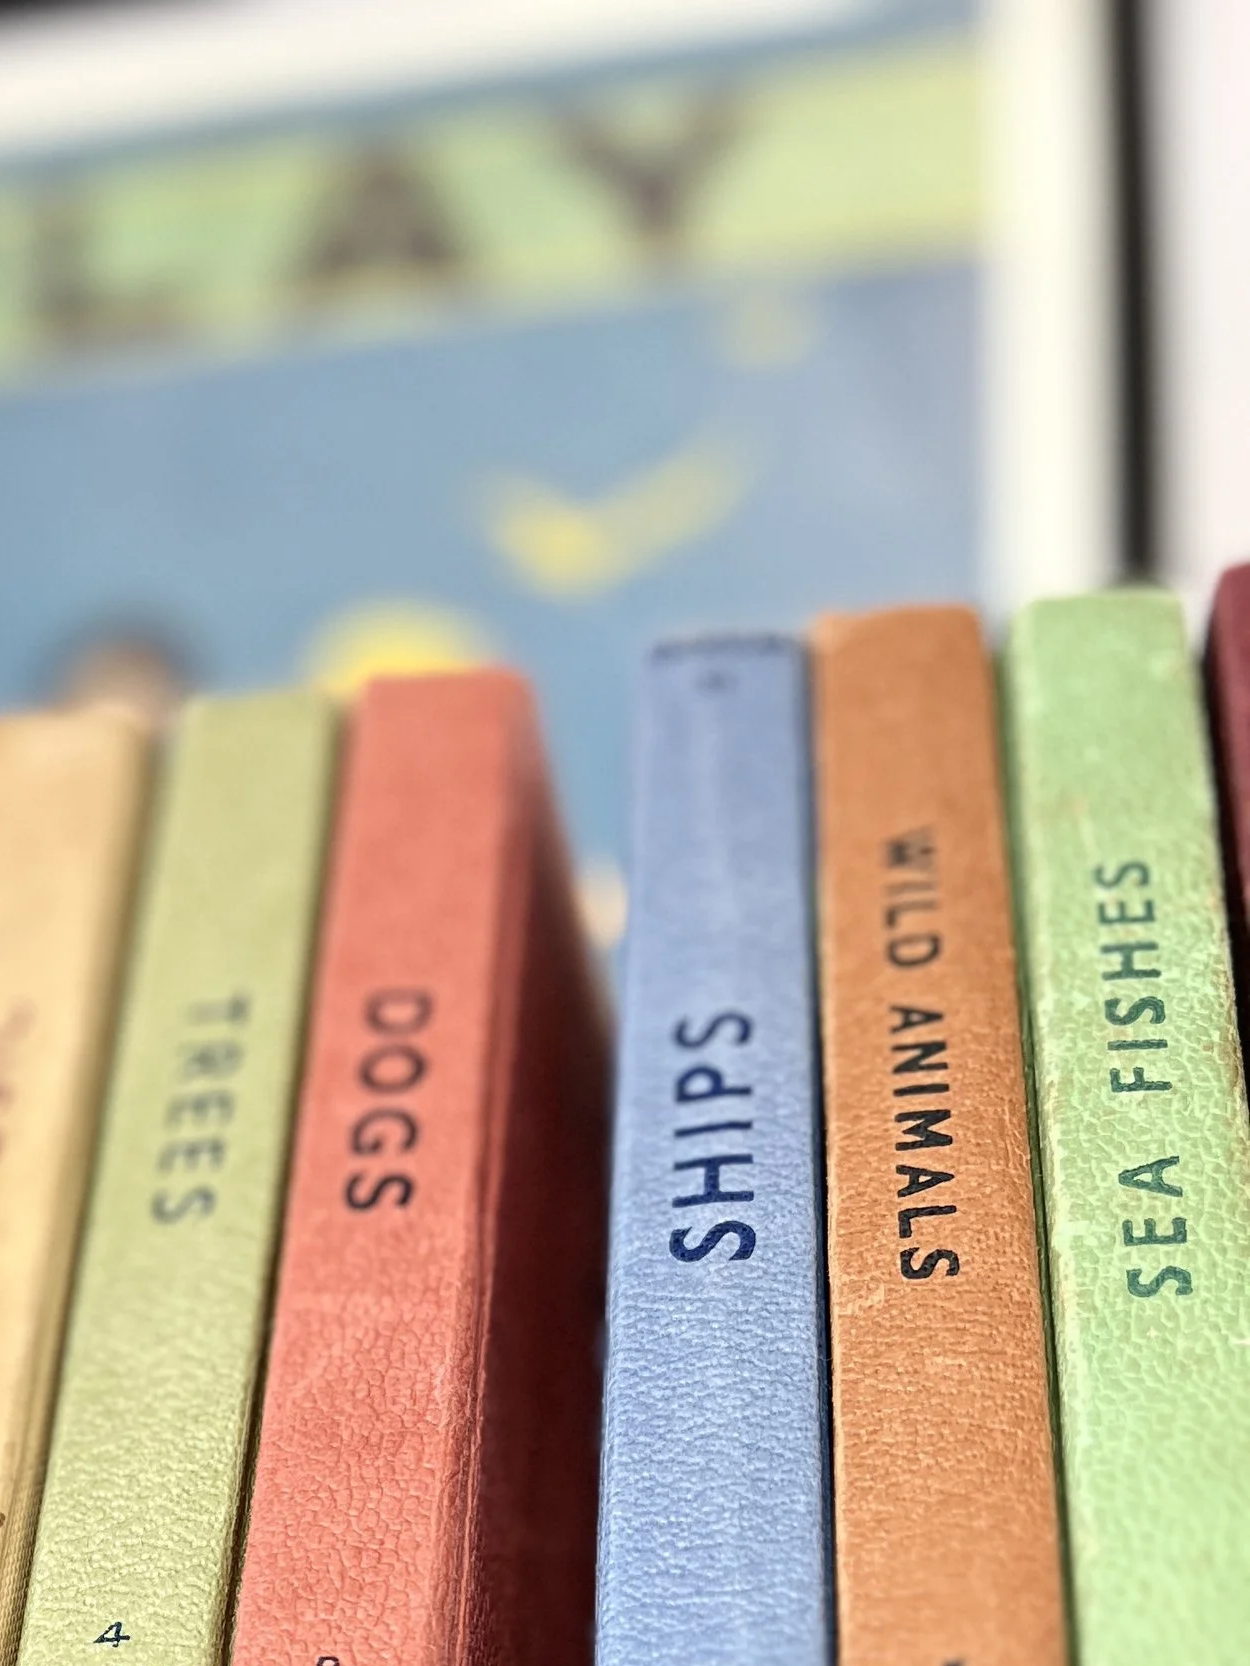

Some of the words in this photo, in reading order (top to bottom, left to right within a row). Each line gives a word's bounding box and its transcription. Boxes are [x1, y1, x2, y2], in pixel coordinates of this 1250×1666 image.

[883, 826, 943, 969] WILD
[1093, 860, 1172, 1092] FISHES
[152, 994, 250, 1226] TREES
[344, 988, 431, 1215] DOGS
[668, 1010, 756, 1263] SHIPS
[890, 1005, 960, 1281] ANIMALS
[1118, 1155, 1193, 1298] SEA
[93, 1621, 130, 1647] 4
